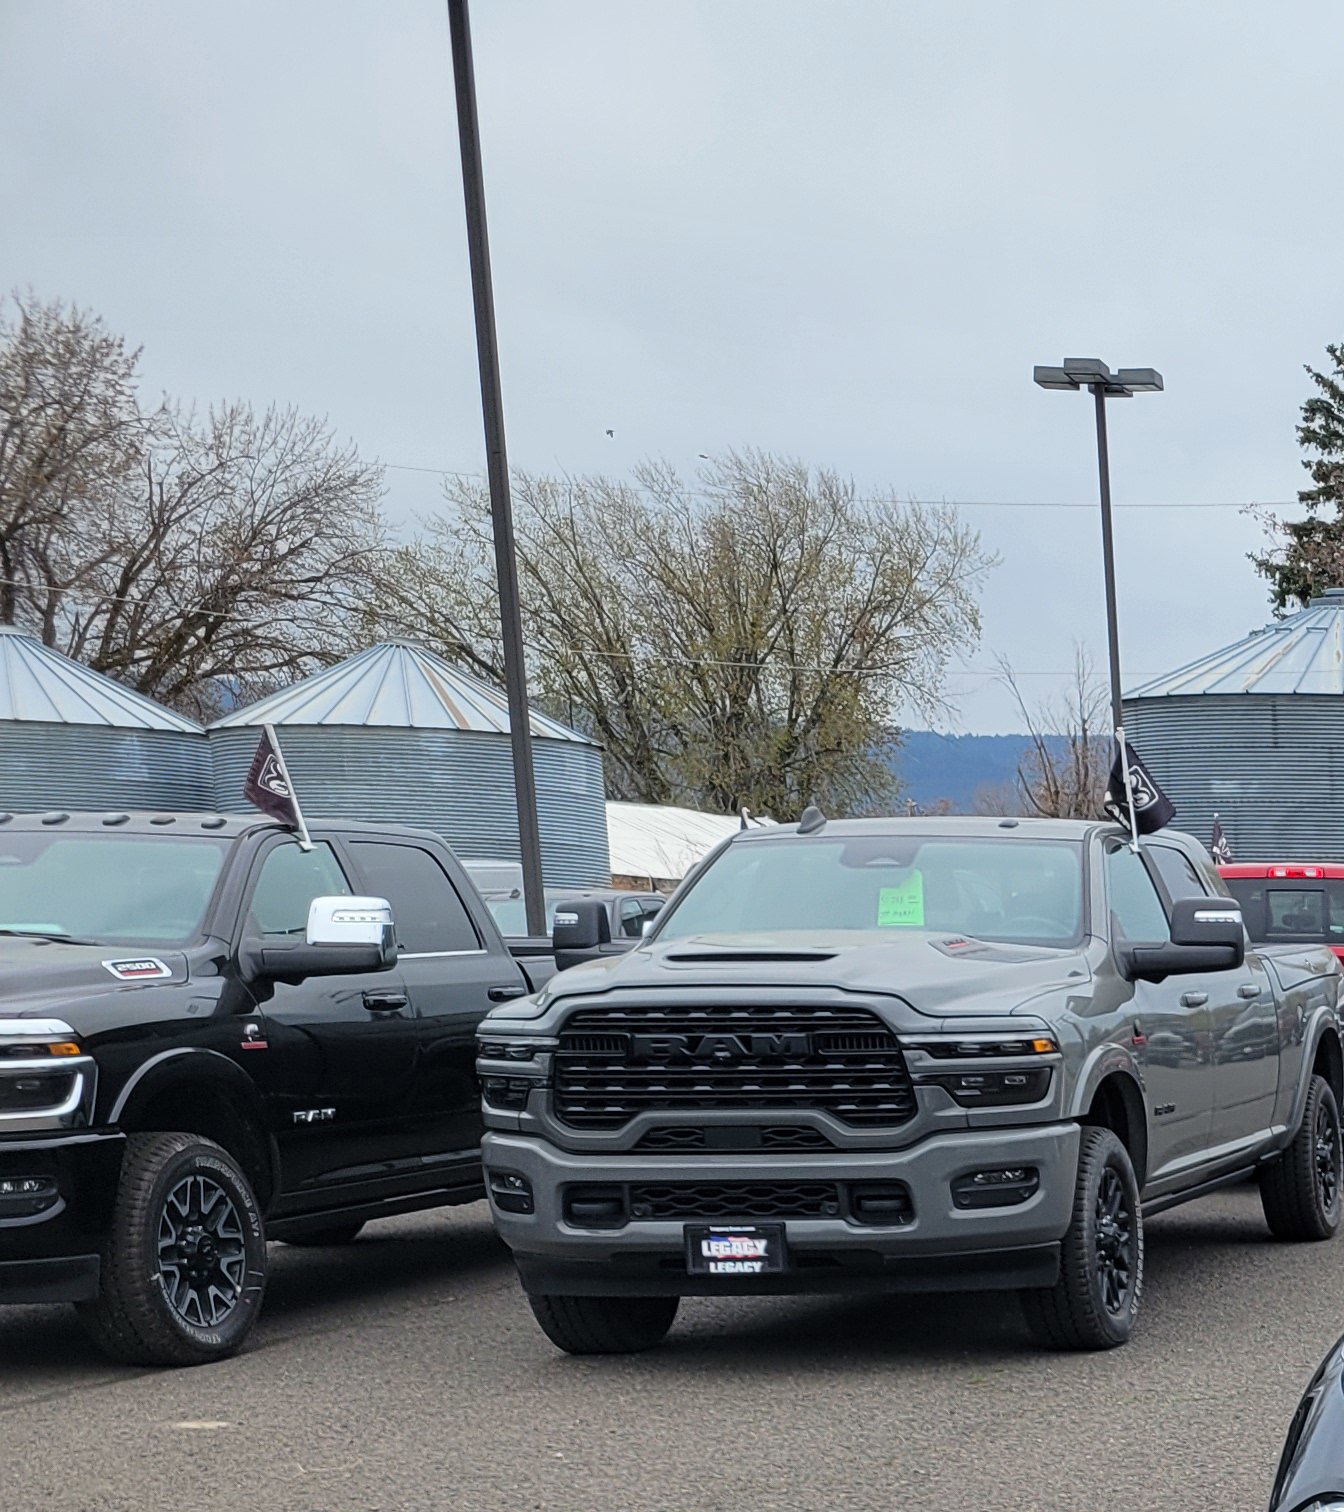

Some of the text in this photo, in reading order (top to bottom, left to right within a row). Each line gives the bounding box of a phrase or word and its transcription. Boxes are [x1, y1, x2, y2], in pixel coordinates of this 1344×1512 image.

[633, 1032, 808, 1057] RAM
[293, 1108, 336, 1123] RAM
[701, 1239, 769, 1257] LEGACY
[709, 1261, 763, 1273] LEGACY
